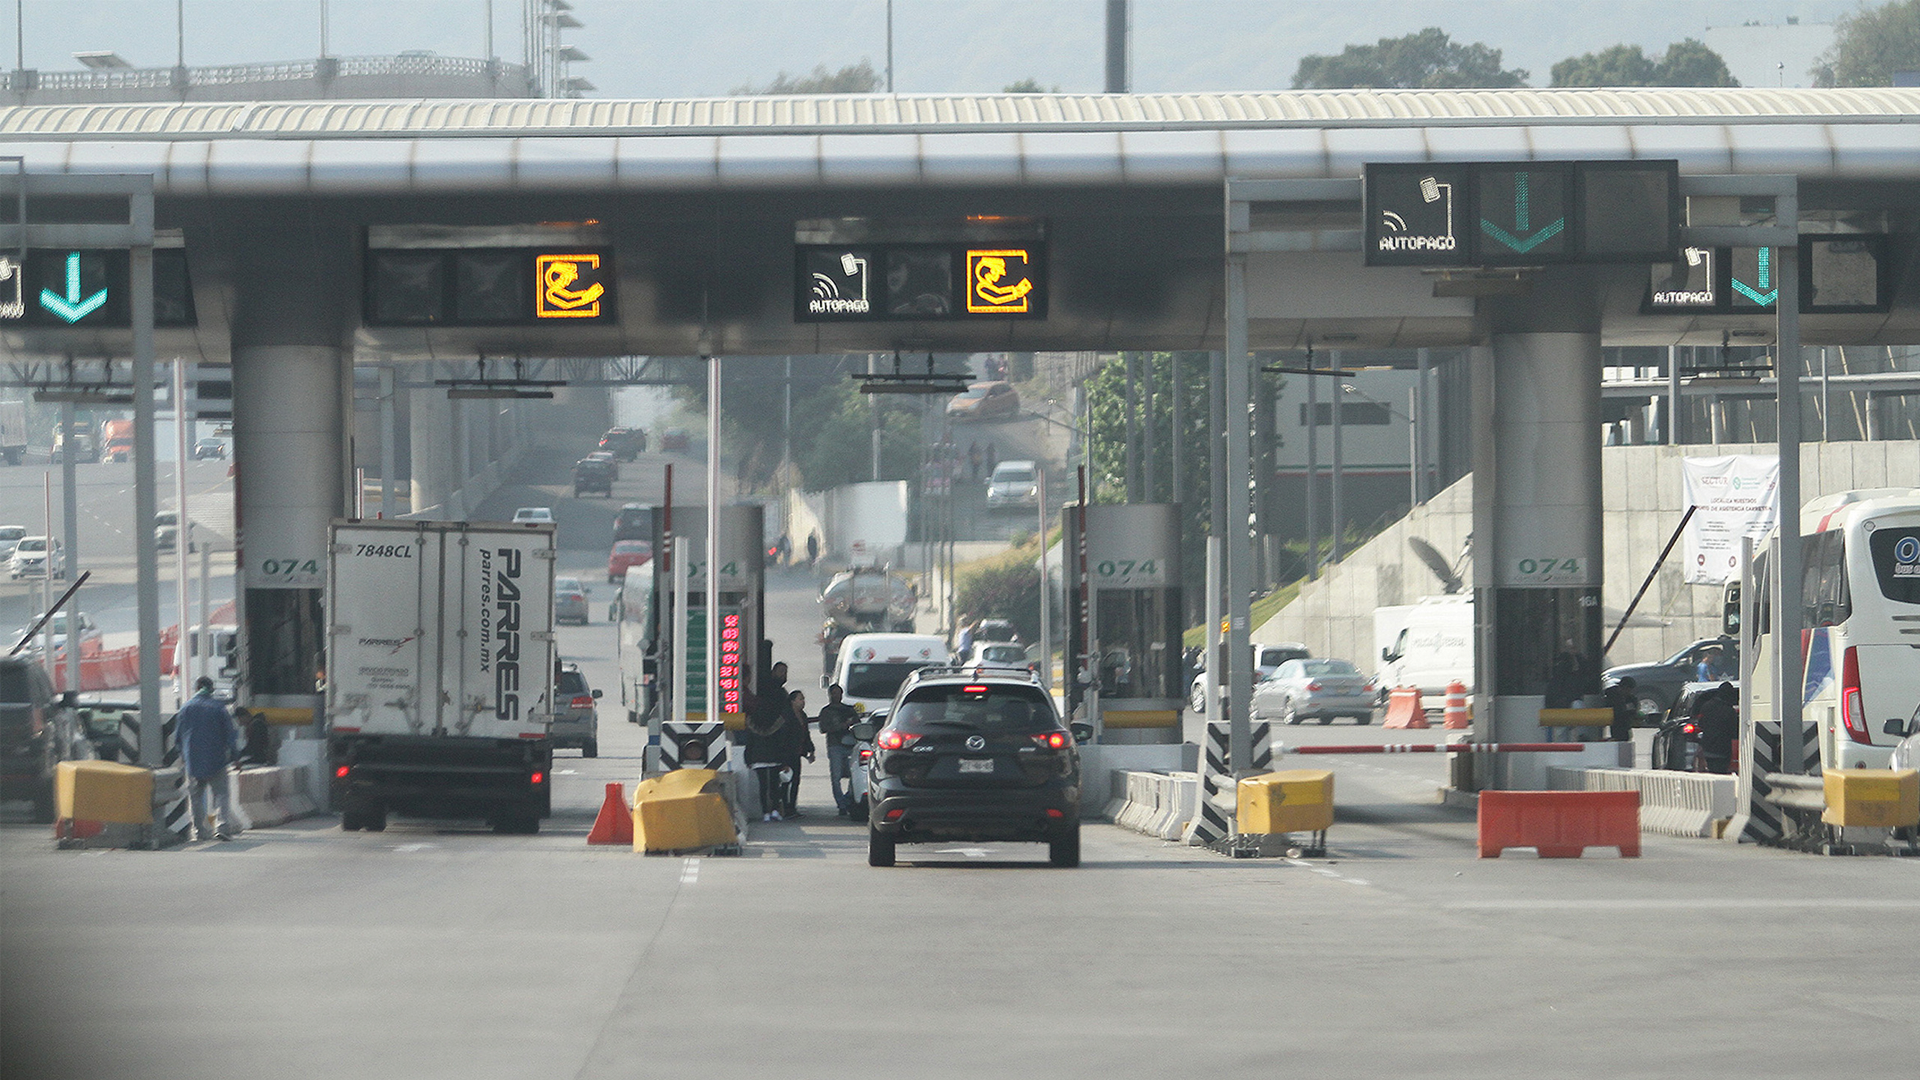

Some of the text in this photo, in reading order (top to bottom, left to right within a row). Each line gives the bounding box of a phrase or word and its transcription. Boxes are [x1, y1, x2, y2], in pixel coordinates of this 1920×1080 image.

[1379, 235, 1456, 250] AUTOPAGO
[1653, 291, 1713, 303] AUTOPAGO
[809, 299, 869, 313] AUTOPAGO
[356, 544, 412, 558] 7848CL
[1894, 536, 1920, 564] O
[262, 559, 318, 575] 074
[1098, 559, 1158, 577] 074
[1519, 558, 1579, 574] 074
[1579, 596, 1598, 607] 16A
[480, 549, 491, 673] parres.com.mx
[724, 614, 739, 627] 52
[495, 548, 521, 721] PARRES
[722, 627, 739, 640] 103
[724, 690, 739, 702] 53
[724, 703, 739, 714] 97
